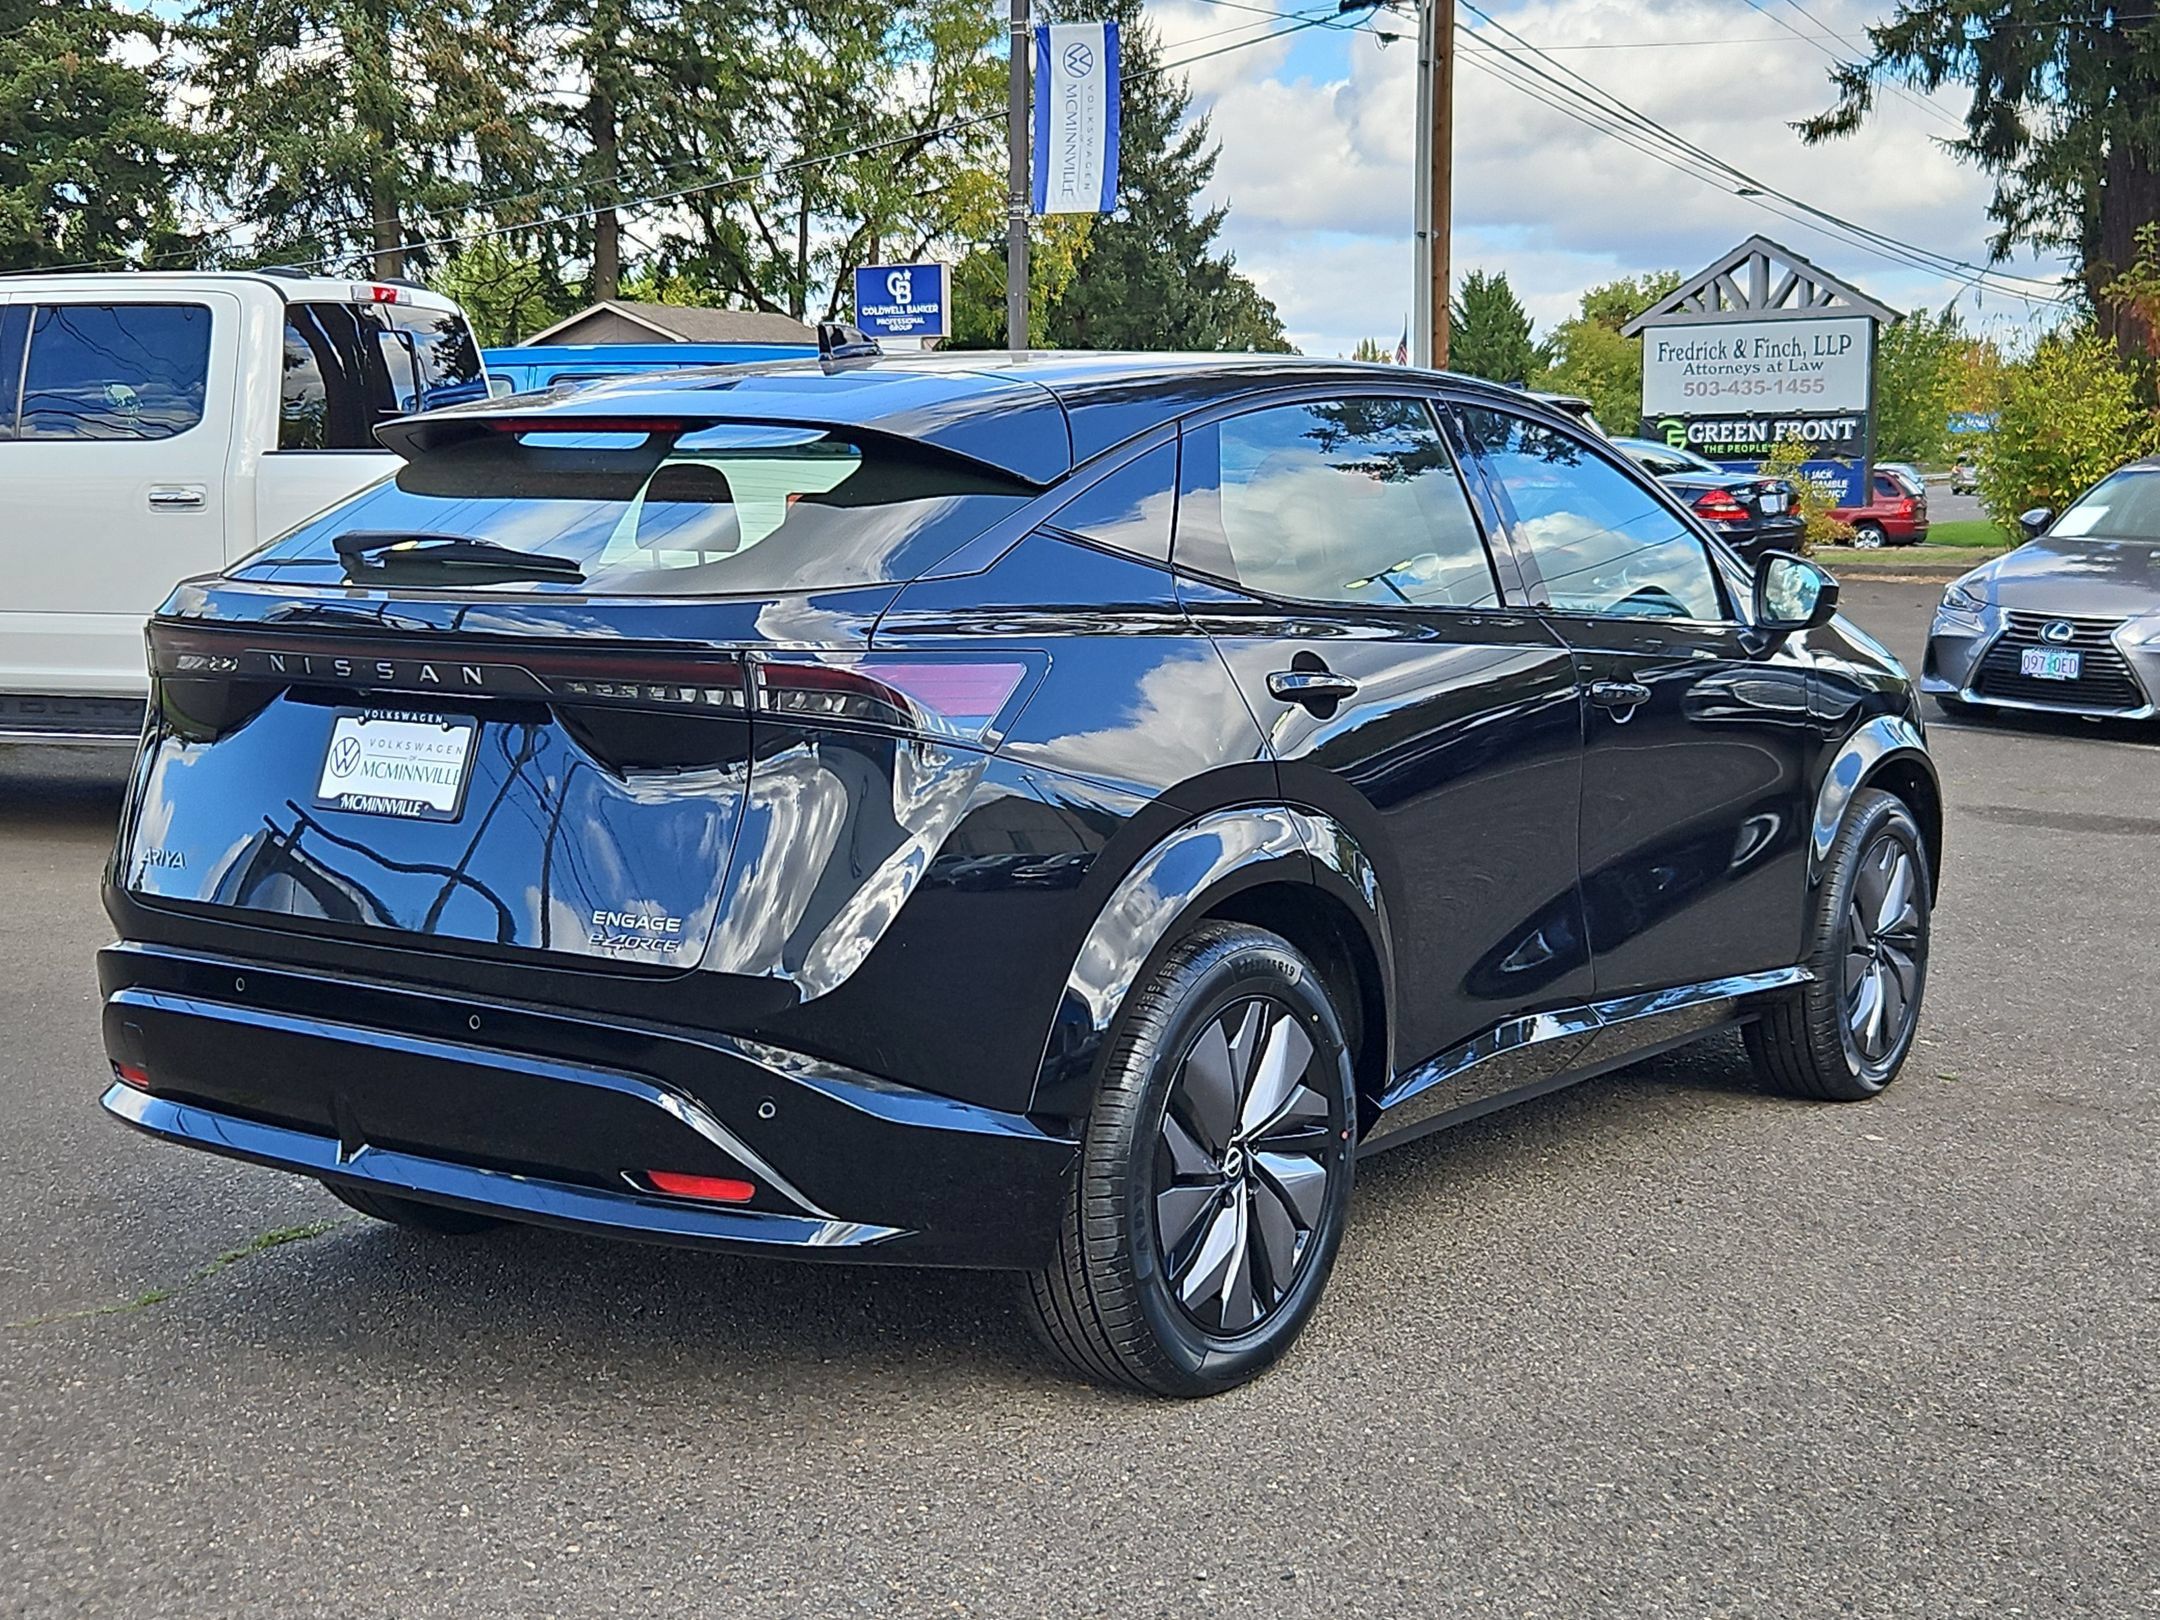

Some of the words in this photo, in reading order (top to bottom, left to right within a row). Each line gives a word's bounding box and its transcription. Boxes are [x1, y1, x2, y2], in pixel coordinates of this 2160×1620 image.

[1062, 84, 1077, 197] MCMINNVILLE
[1084, 84, 1094, 190] VOLKSWAGEN
[862, 305, 905, 316] COLDWELL
[907, 303, 939, 314] BANKER
[876, 316, 925, 325] PROFESSIONAL
[1657, 338, 1727, 362] Fredrick
[1733, 338, 1748, 359] &
[1753, 336, 1807, 361] Finch,
[1814, 334, 1852, 356] LLP
[1682, 362, 1760, 376] Attorneys
[1766, 361, 1783, 373] at
[1788, 359, 1824, 373] Law
[1683, 378, 1825, 397] 503-435-1455
[1687, 421, 1768, 443] GREEN
[1773, 418, 1857, 441] FRONT
[1703, 444, 1724, 454] THE
[1811, 469, 1833, 479] JACK
[270, 654, 483, 685] NISSAN
[2024, 655, 2045, 670] 097
[364, 709, 444, 723] VOLKSWAGEN
[369, 738, 464, 755] VOLKSWAGEN
[340, 794, 422, 816] MCMINNVILLE
[142, 847, 187, 869] ARIYA
[592, 910, 682, 932] ENGAGE
